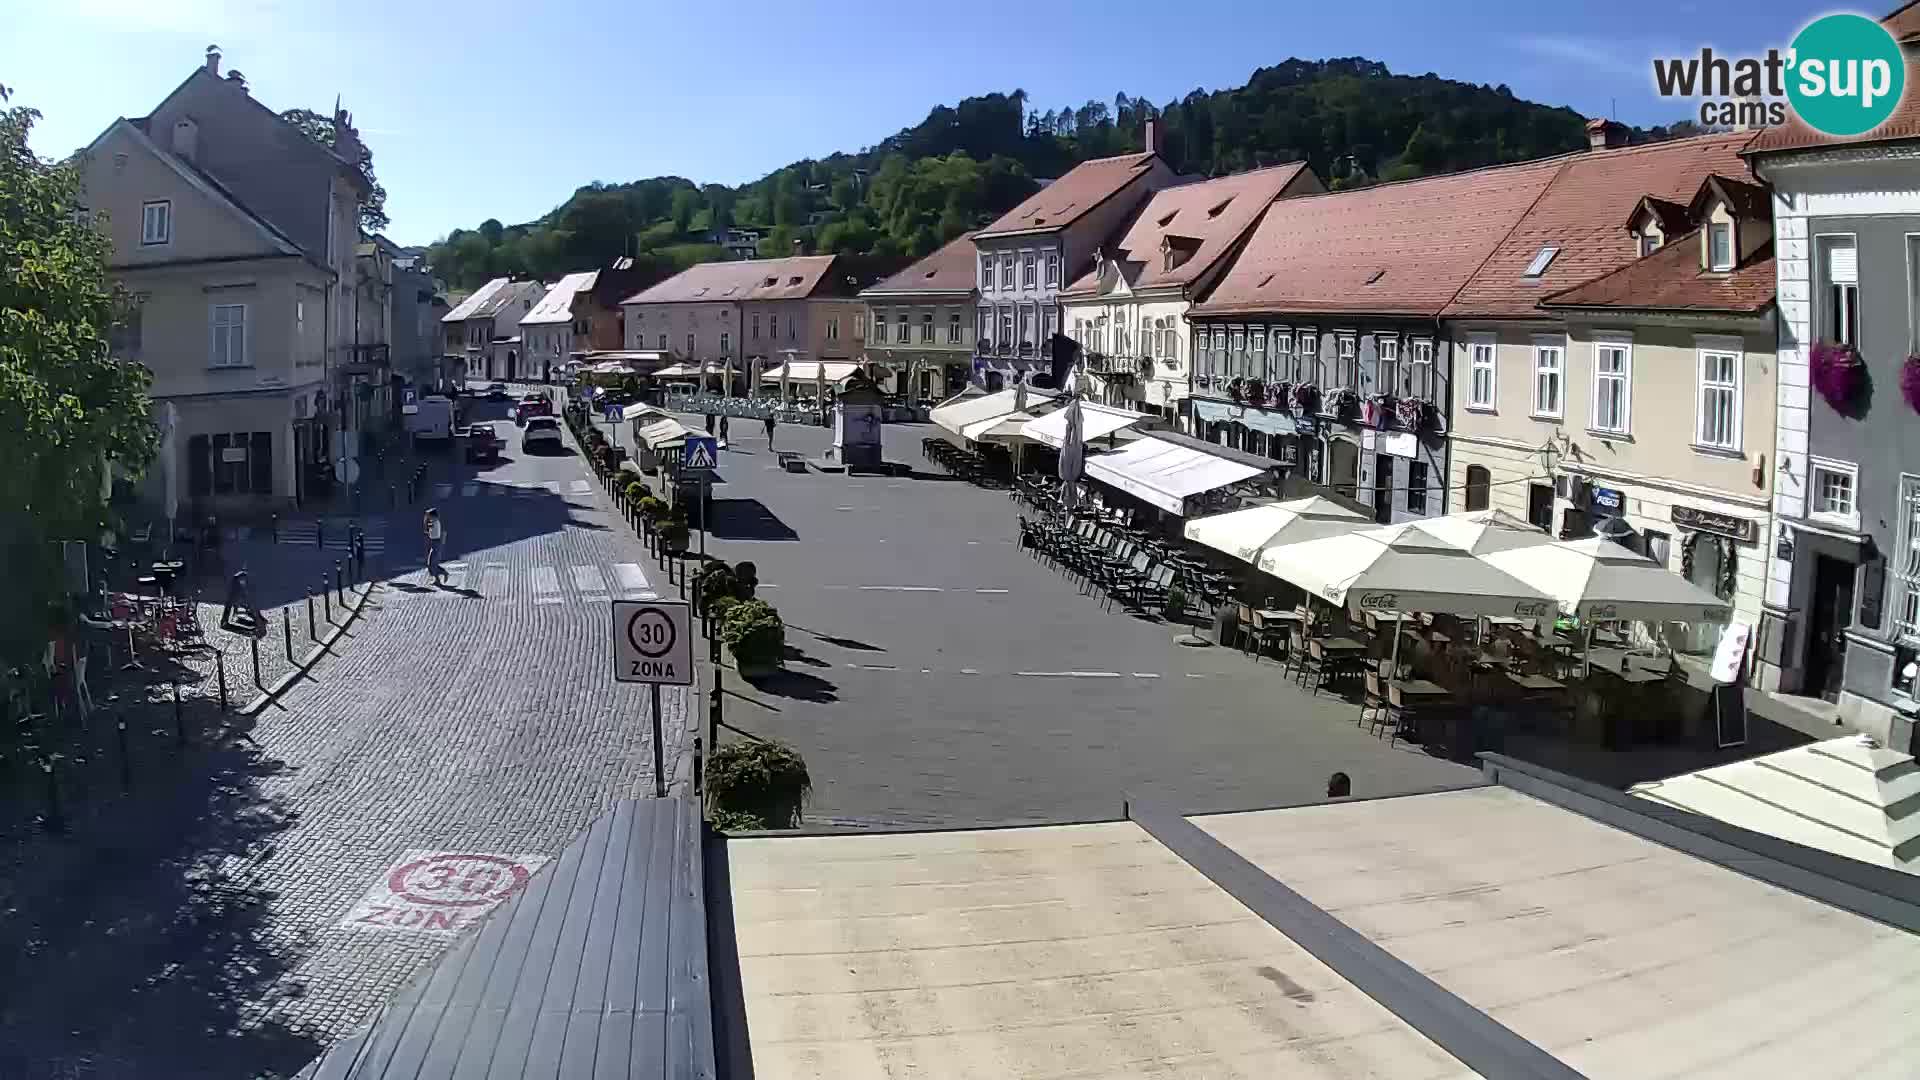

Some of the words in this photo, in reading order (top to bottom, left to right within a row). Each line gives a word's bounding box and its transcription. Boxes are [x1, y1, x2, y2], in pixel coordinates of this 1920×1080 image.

[406, 391, 414, 403] P
[640, 623, 664, 644] 30
[631, 660, 675, 677] ZONA
